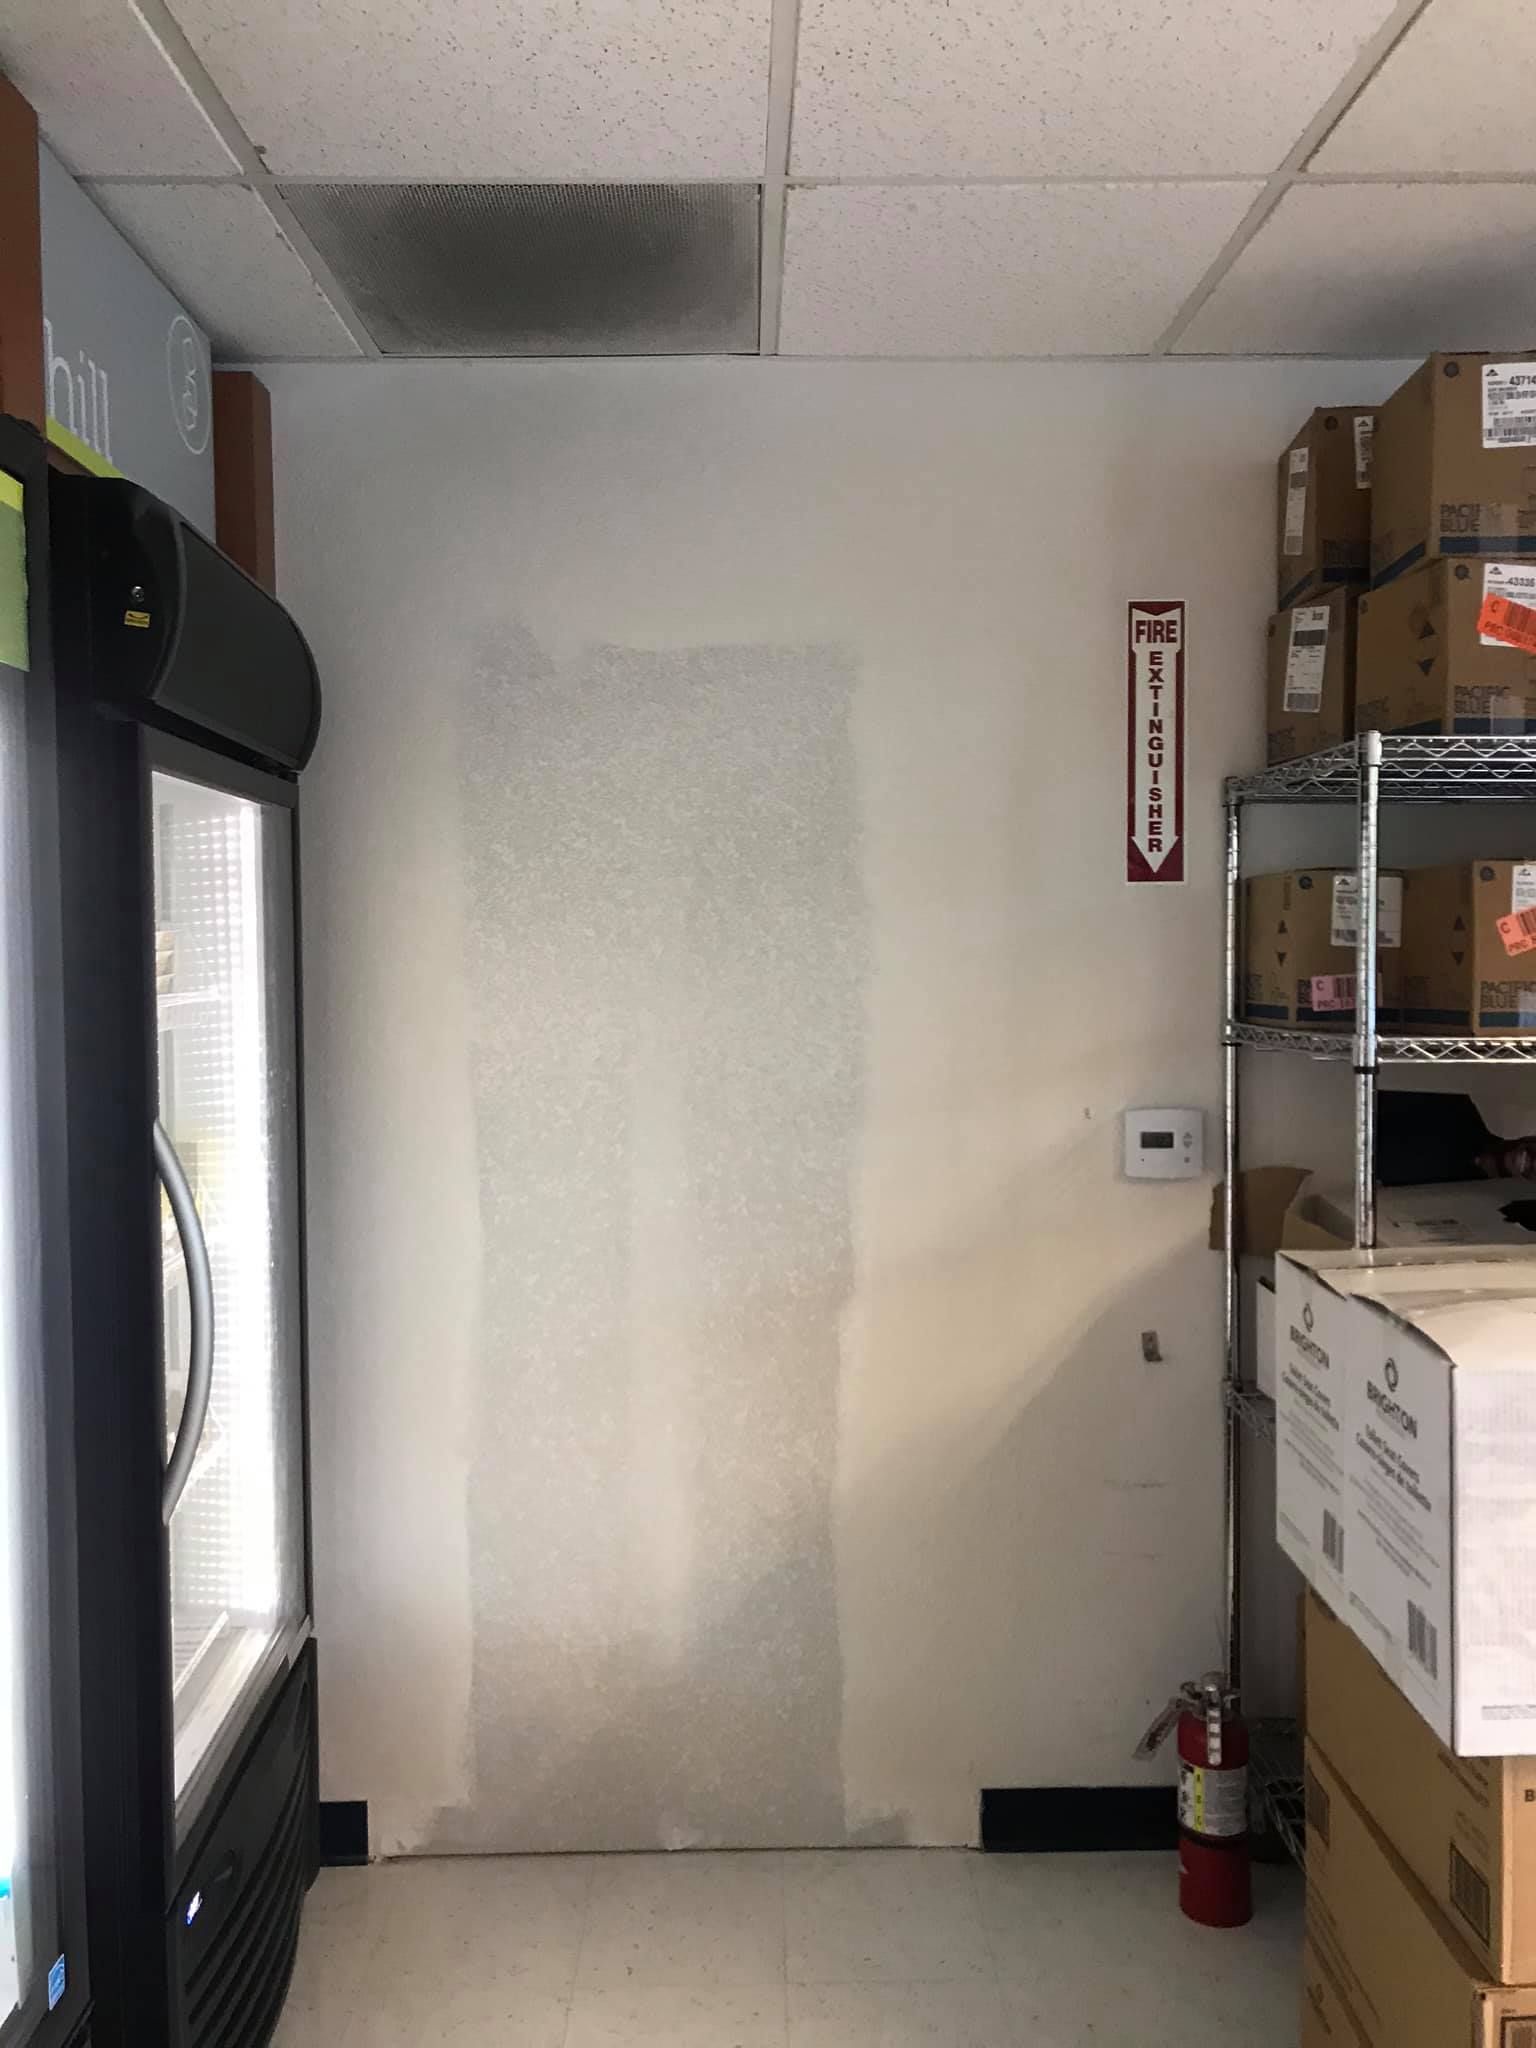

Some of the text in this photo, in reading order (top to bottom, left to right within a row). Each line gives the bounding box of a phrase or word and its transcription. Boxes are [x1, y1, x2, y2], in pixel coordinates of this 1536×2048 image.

[1135, 620, 1178, 643] FIRE
[1148, 651, 1164, 852] EXTINGUISHER
[1290, 1325, 1329, 1369] BRIGHTON
[1367, 1379, 1417, 1439] BRIGHTON
